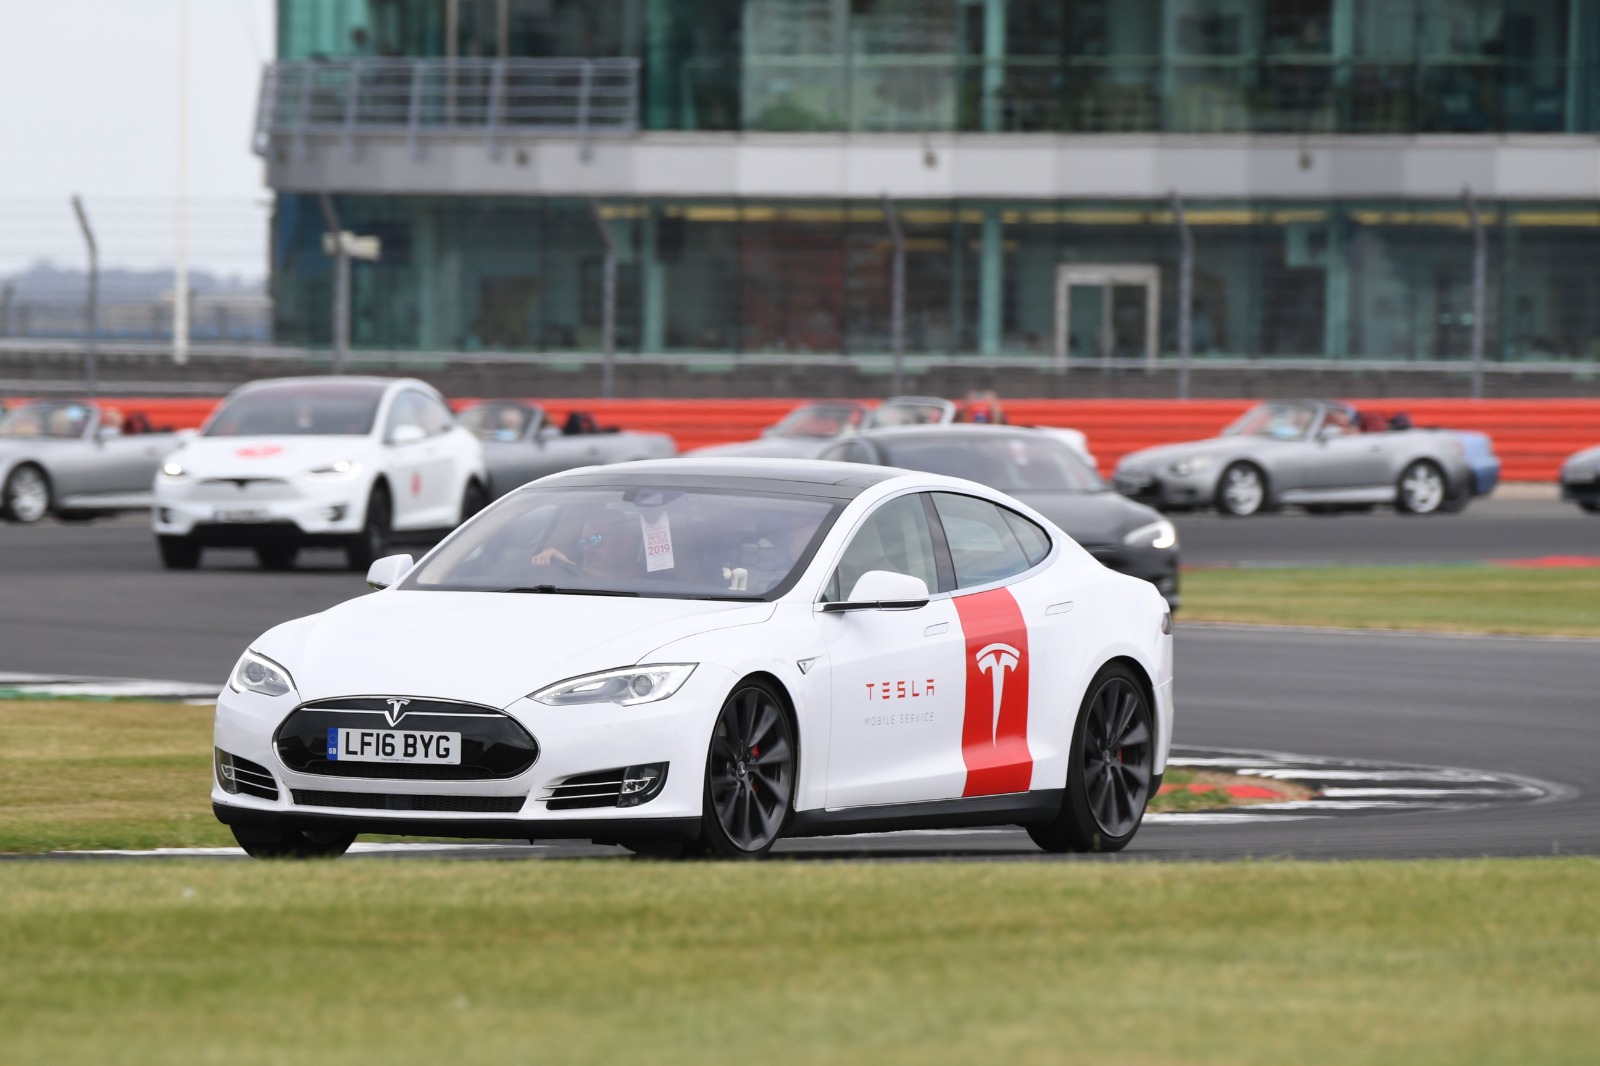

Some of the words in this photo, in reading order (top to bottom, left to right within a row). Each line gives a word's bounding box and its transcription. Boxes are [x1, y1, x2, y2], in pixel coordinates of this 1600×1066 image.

[647, 543, 670, 556] 2019
[865, 679, 935, 701] TESLA
[864, 714, 896, 727] MOBILE
[899, 711, 935, 724] SERVICE
[328, 747, 337, 755] GB
[345, 731, 396, 757] LF16
[403, 733, 451, 759] BYG
